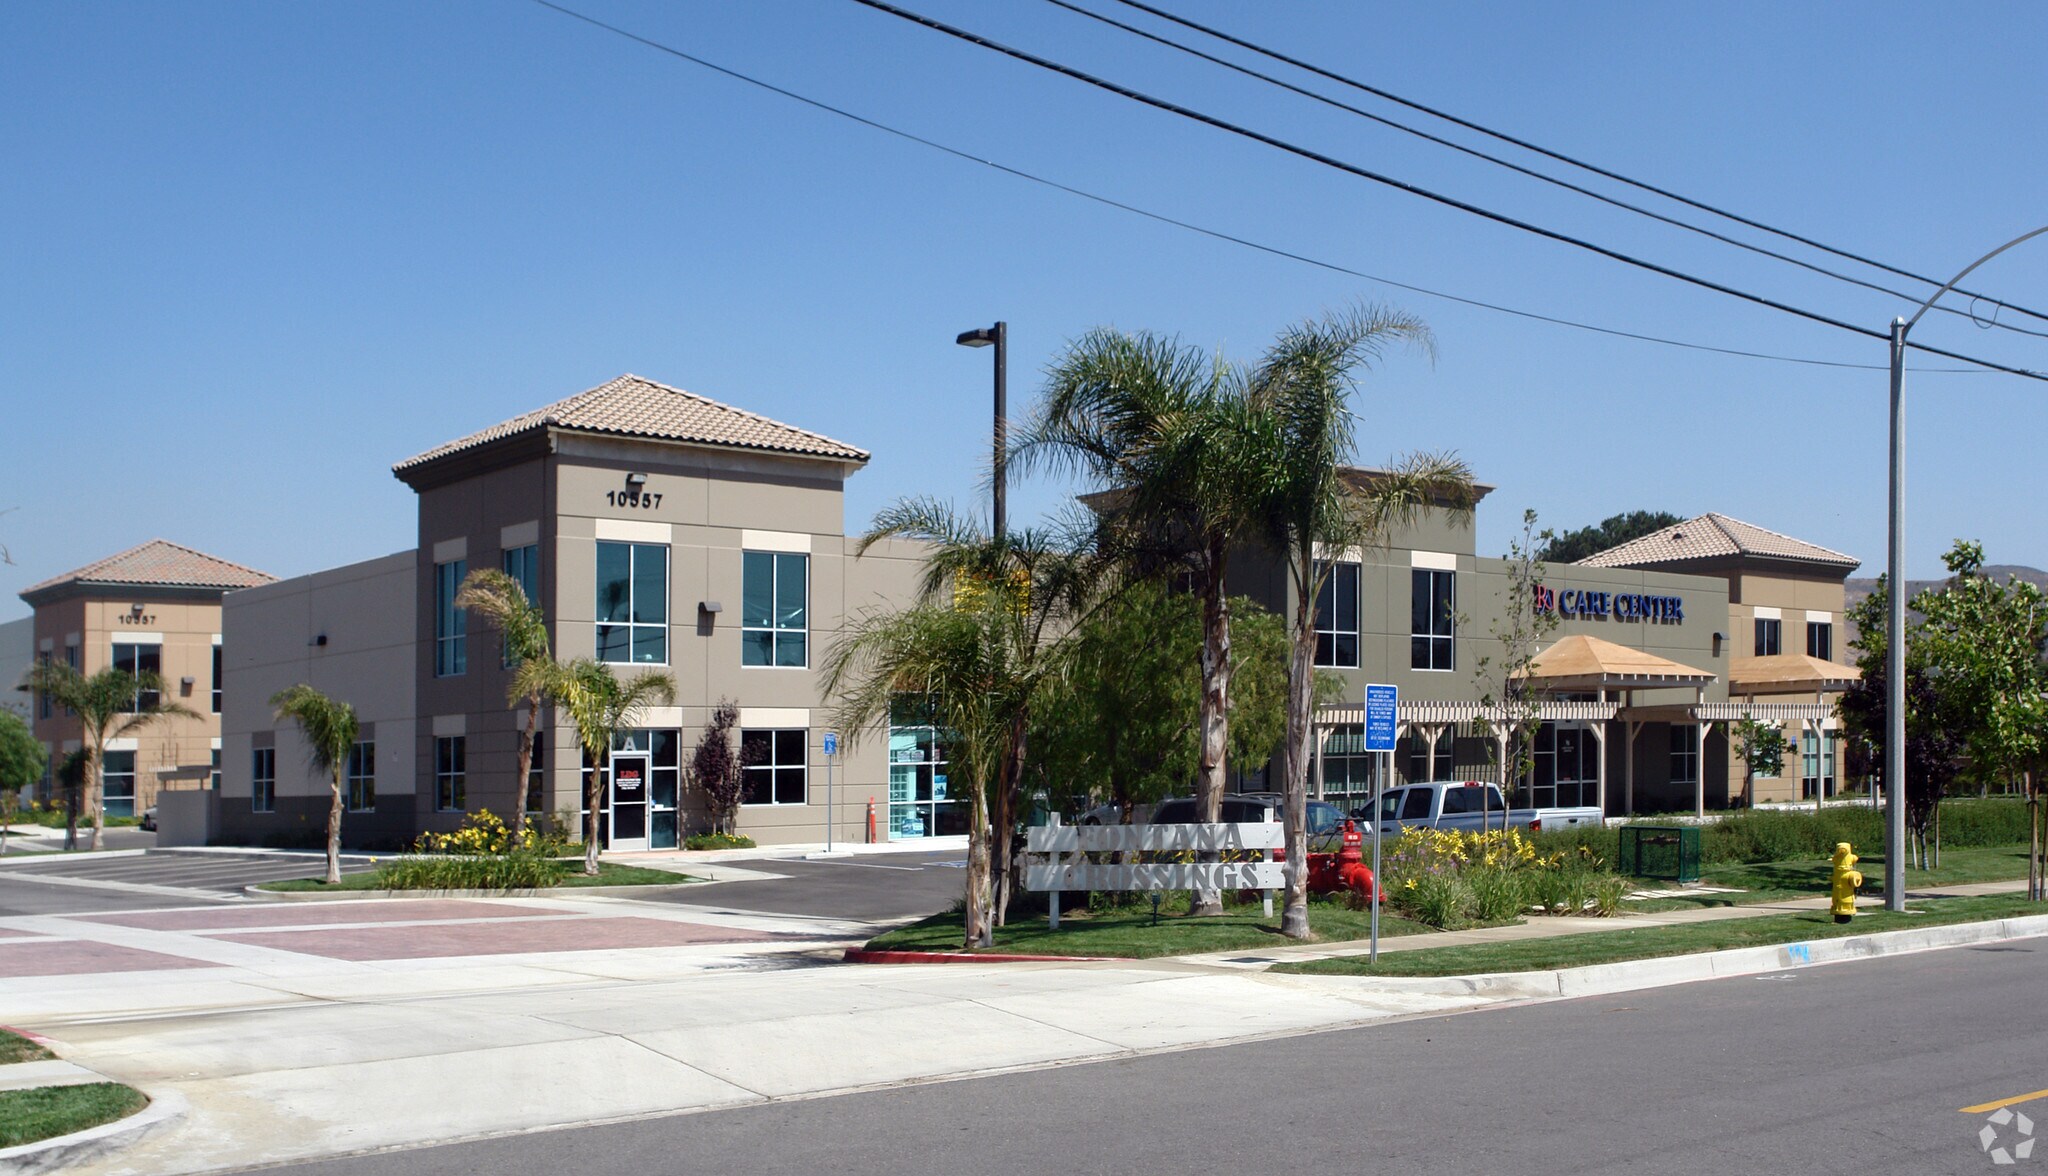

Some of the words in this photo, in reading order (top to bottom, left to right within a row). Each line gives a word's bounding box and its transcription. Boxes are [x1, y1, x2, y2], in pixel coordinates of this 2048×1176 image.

[606, 490, 663, 510] 10557
[1559, 588, 1612, 616] CARE
[1613, 592, 1685, 620] CENTER
[118, 615, 156, 625] 10557
[622, 736, 637, 751] A
[1077, 823, 1245, 851] FONTANA
[1063, 862, 1260, 891] CROSSINGS
